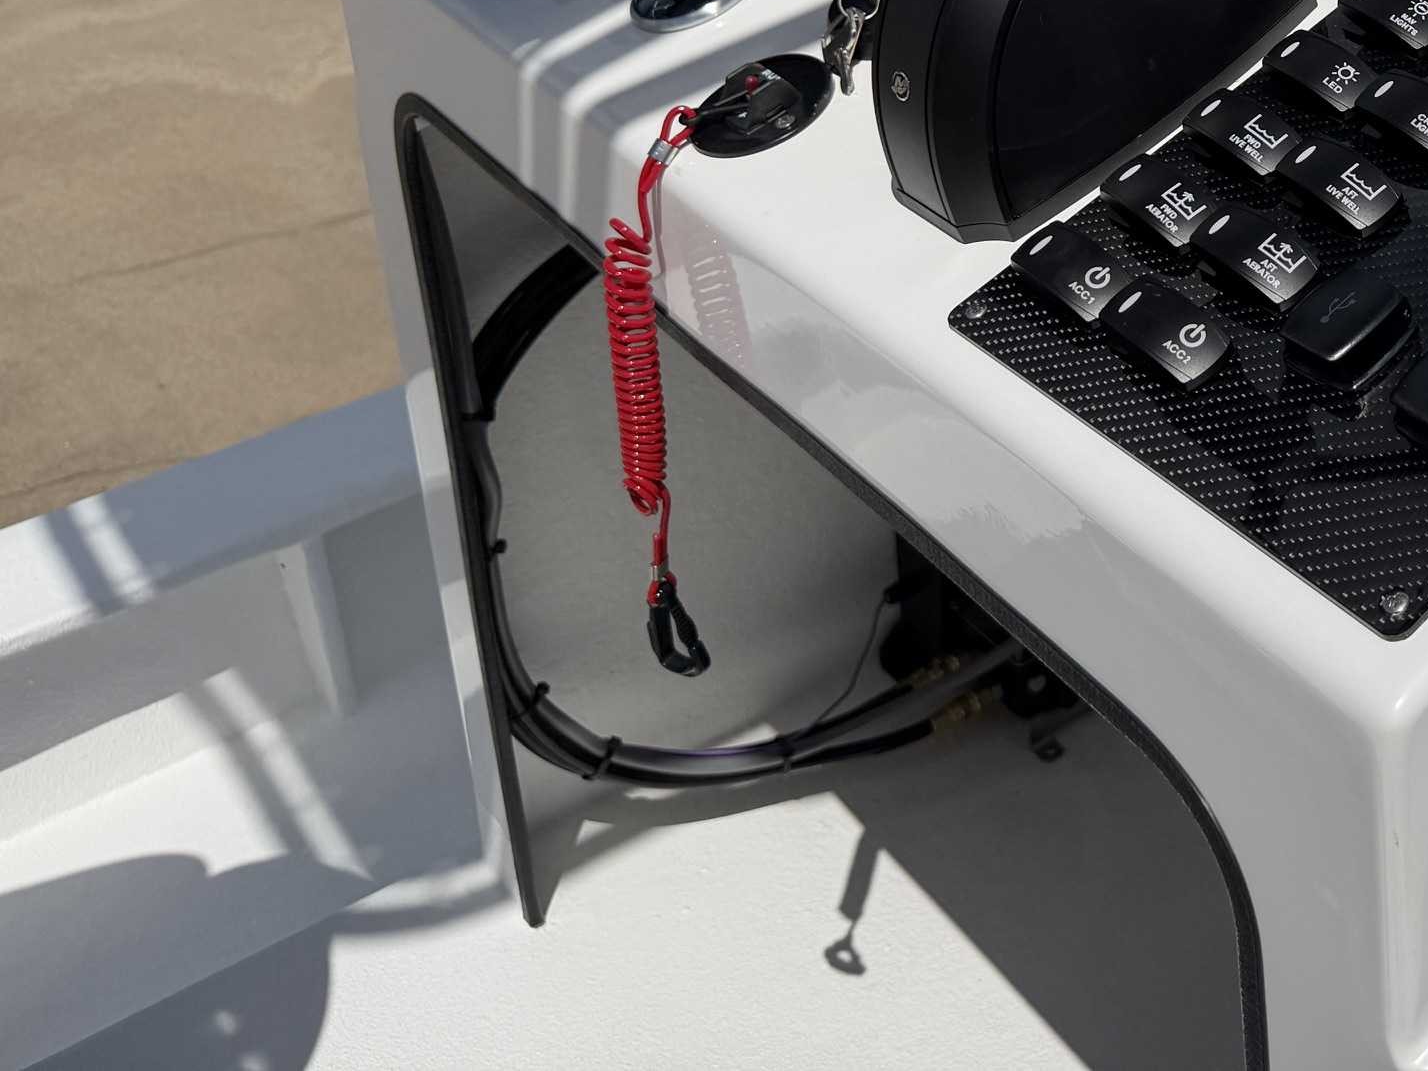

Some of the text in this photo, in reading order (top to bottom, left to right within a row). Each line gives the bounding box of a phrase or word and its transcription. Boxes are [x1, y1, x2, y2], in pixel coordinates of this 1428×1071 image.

[1389, 14, 1418, 36] LIGHTS
[1322, 76, 1343, 94] LED
[1229, 133, 1264, 162] LIVE WELL
[1243, 133, 1261, 149] FWD
[1325, 184, 1360, 215] LIVE WELL
[1341, 186, 1359, 200] AFT
[1145, 203, 1179, 233] AERATOR
[1160, 203, 1178, 219] FWD
[1242, 258, 1280, 289] AERATOR
[1260, 259, 1278, 273] AFT
